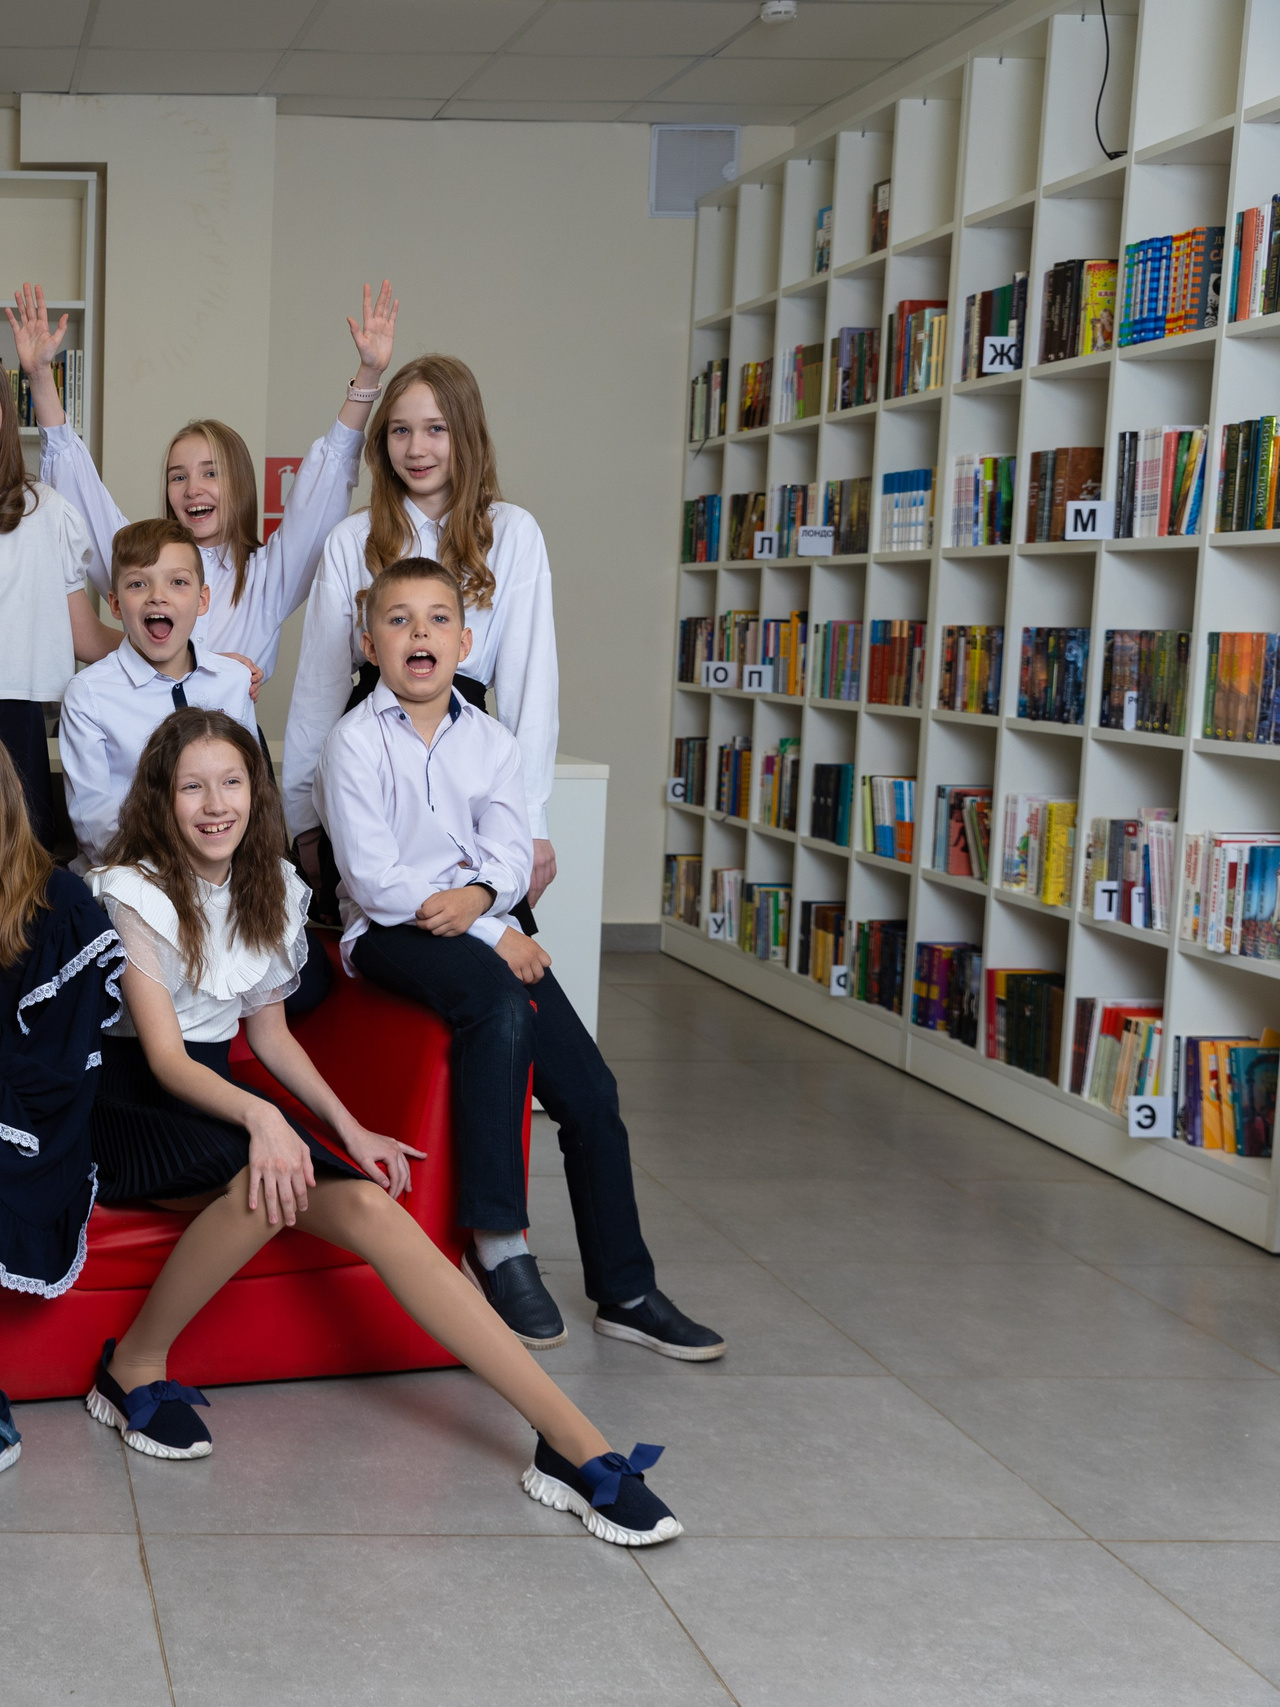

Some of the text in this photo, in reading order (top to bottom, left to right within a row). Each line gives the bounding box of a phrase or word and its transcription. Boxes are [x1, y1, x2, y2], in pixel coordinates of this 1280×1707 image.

[989, 344, 1017, 366] Ж
[1073, 508, 1096, 532] М
[757, 537, 772, 553] Л
[748, 671, 762, 687] П
[1101, 889, 1118, 912] Т
[1135, 1104, 1156, 1130] Э
